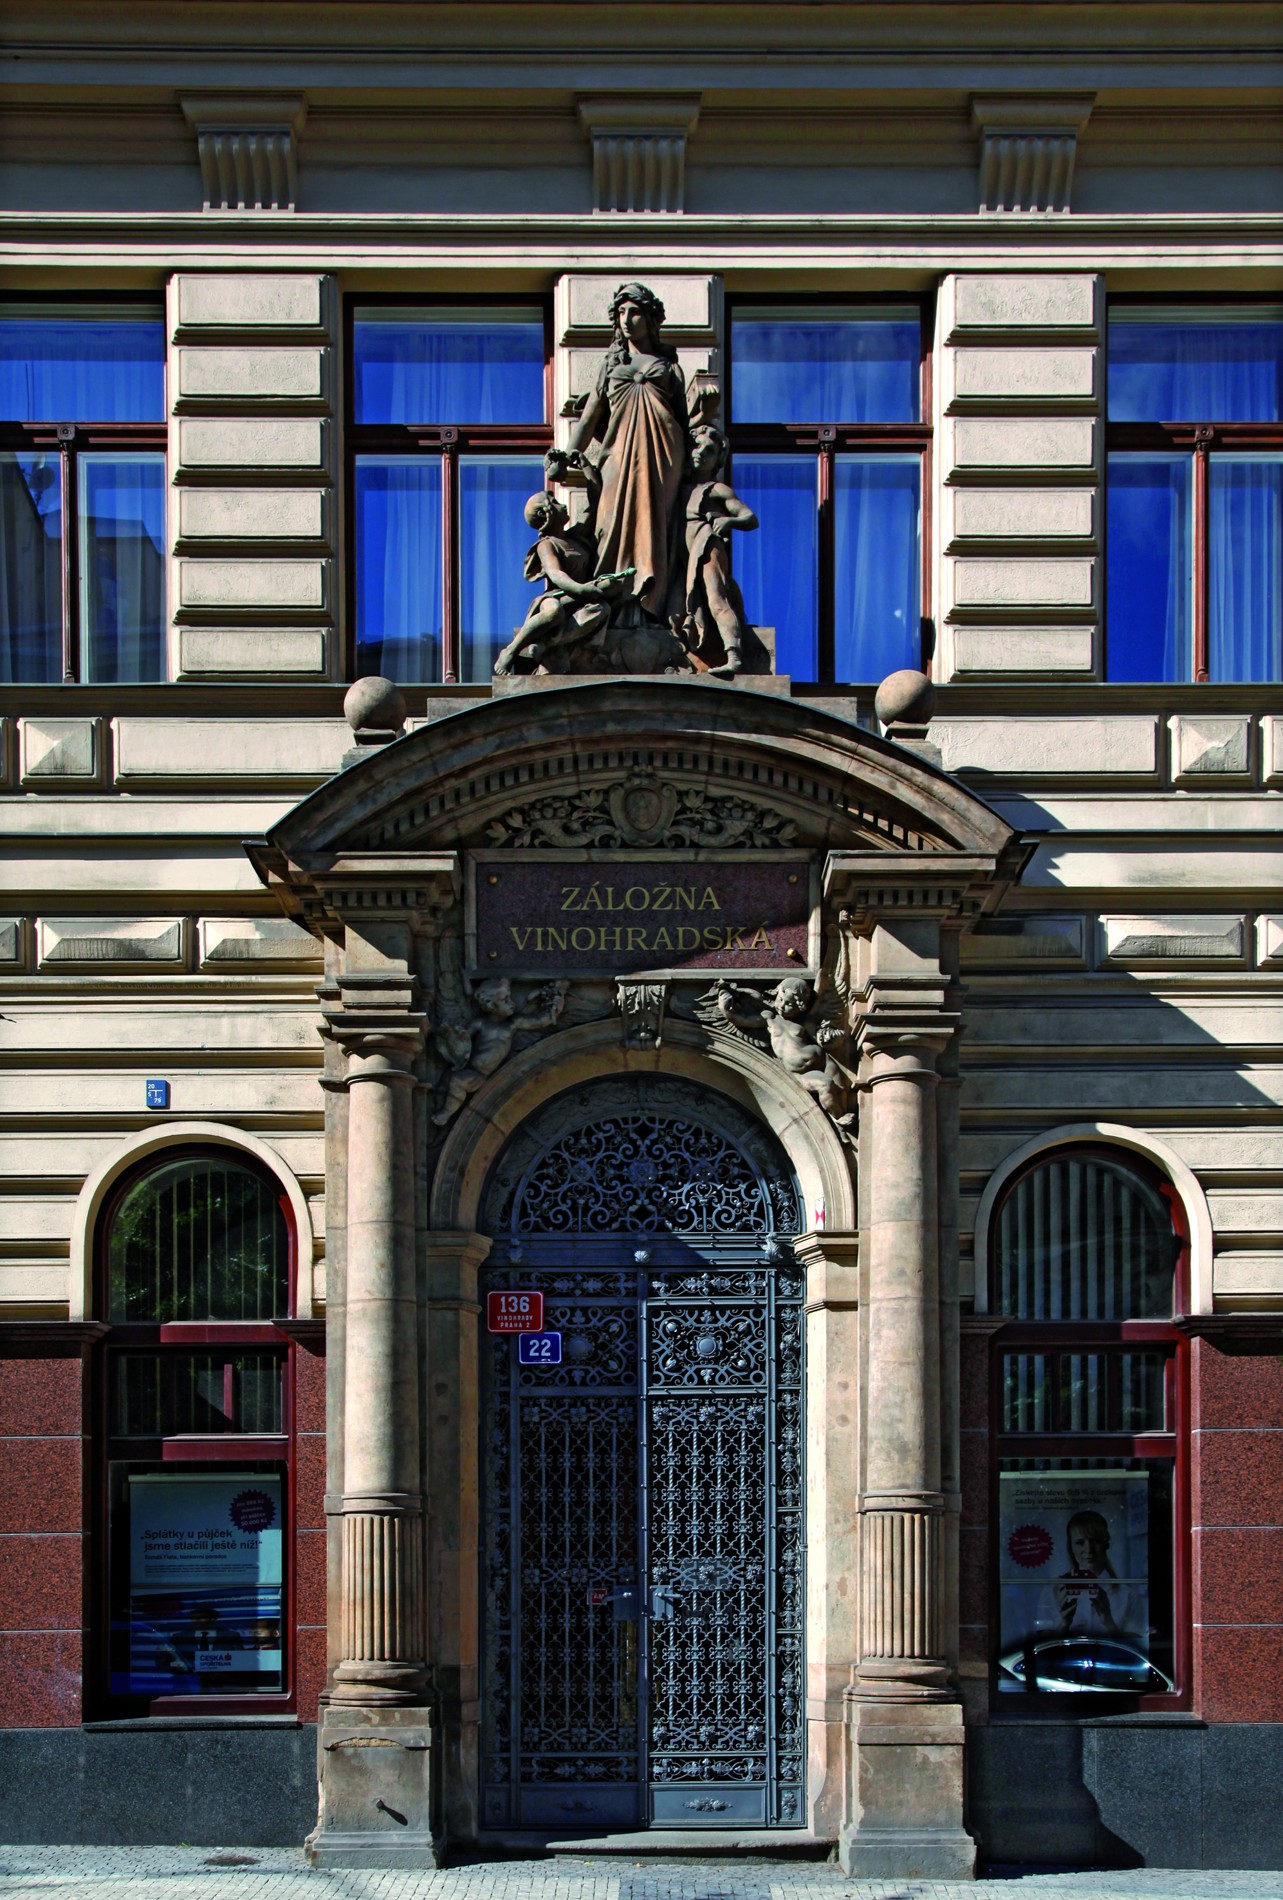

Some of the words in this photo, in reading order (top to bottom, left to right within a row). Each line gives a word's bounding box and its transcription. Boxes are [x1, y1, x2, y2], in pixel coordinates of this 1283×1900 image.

[561, 881, 721, 911] ZÁLOŽNA
[510, 921, 774, 952] VINOHRADSKÁ
[500, 1295, 530, 1313] 136
[529, 1339, 551, 1357] 22
[197, 1529, 233, 1540] půjček
[144, 1541, 171, 1552] jsme
[173, 1540, 208, 1550] stlačili
[210, 1540, 237, 1551] ještě
